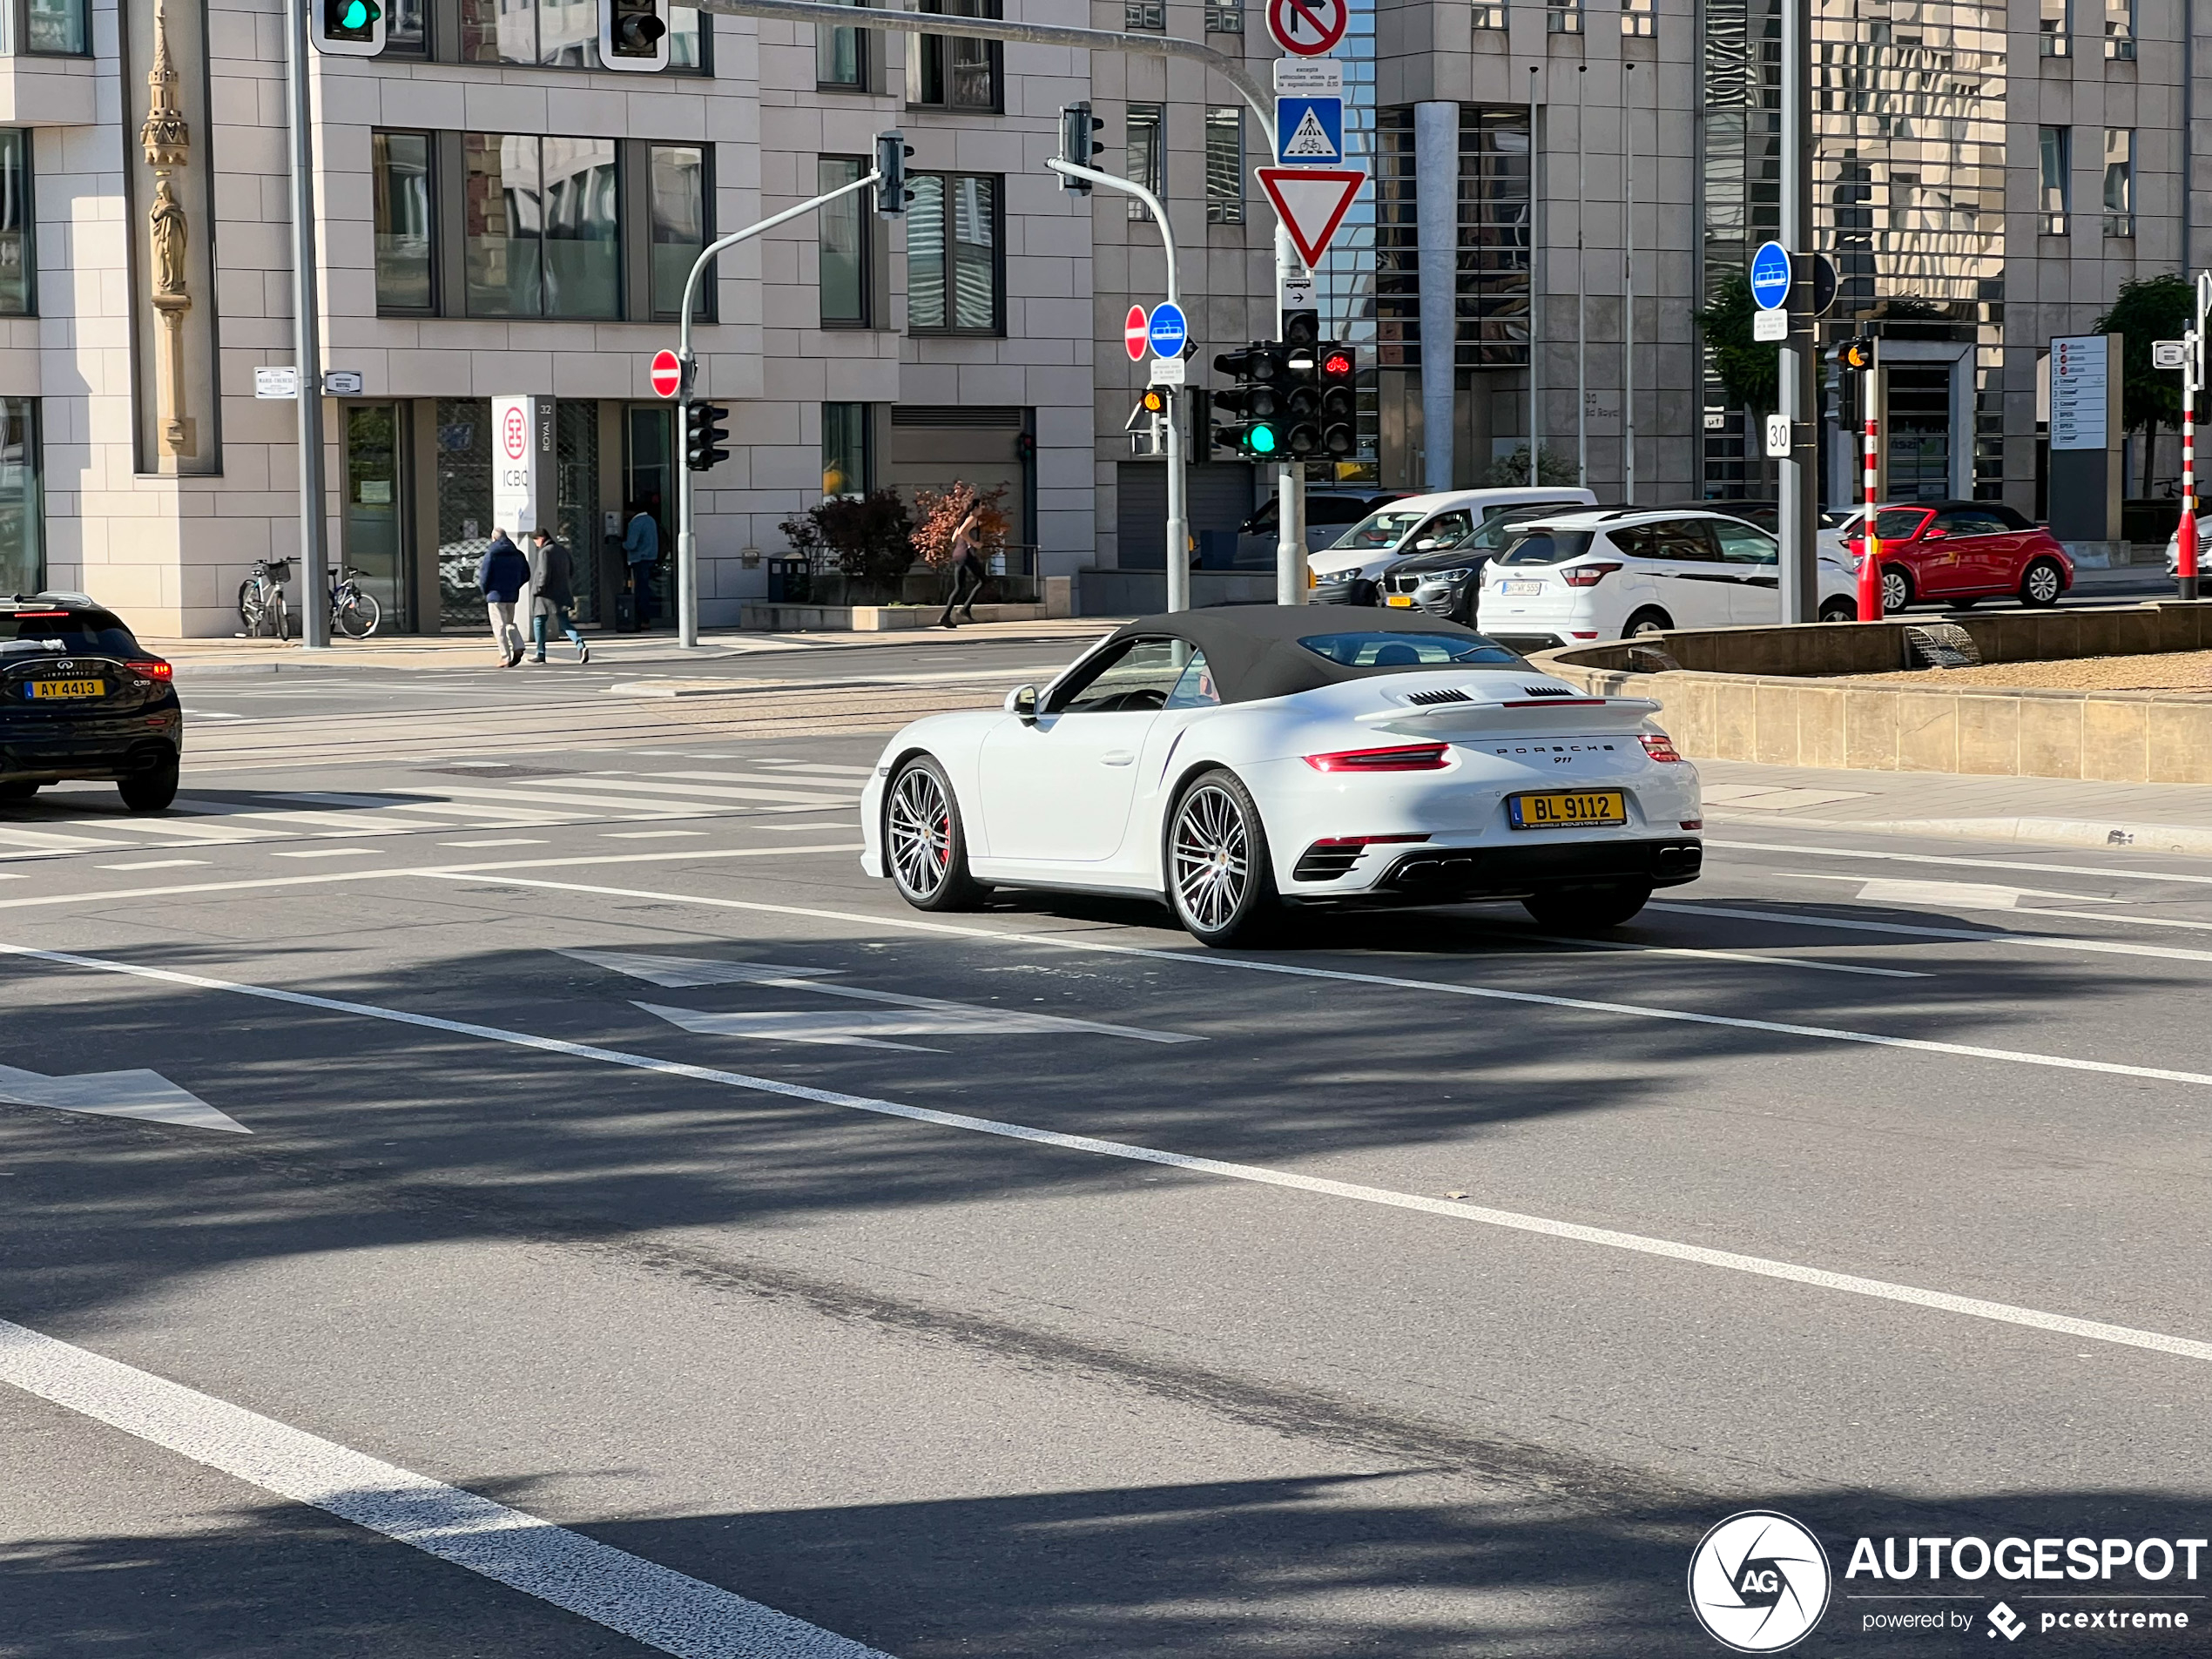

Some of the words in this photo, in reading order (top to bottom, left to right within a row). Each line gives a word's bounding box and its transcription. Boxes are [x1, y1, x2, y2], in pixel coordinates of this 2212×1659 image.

[540, 405, 552, 415] 32
[542, 421, 550, 452] ROYAL
[1770, 425, 1788, 447] 30
[42, 683, 60, 696] AY
[62, 680, 96, 694] 4413
[1496, 745, 1615, 754] PORSCHE
[1514, 812, 1520, 820] L
[1534, 799, 1561, 820] BL
[1565, 796, 1611, 819] 9112
